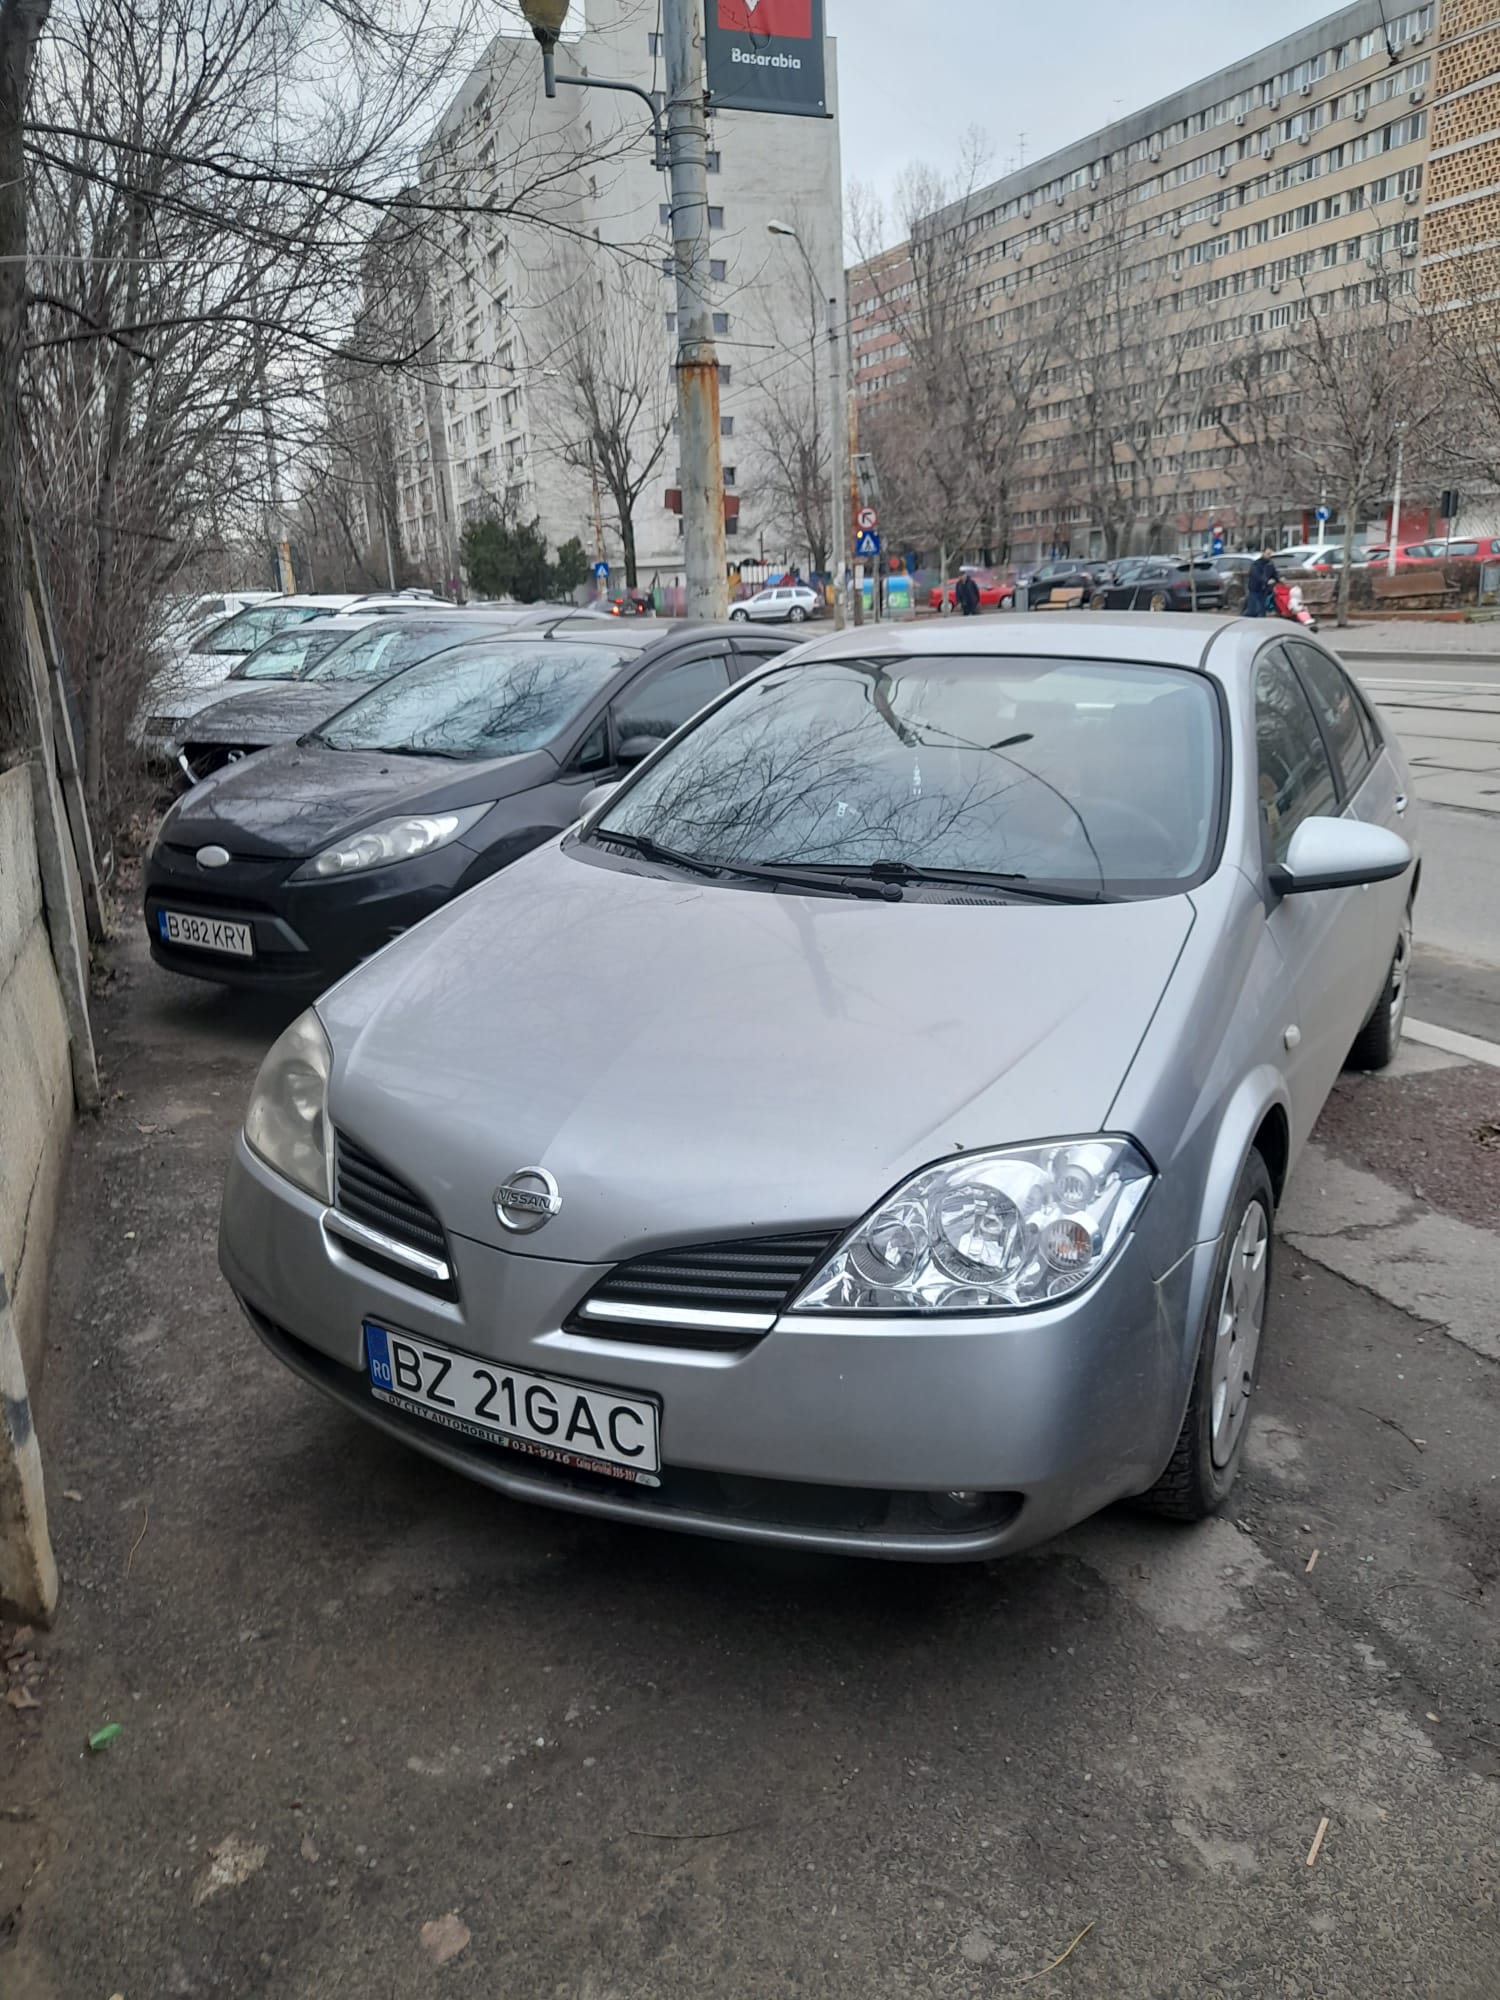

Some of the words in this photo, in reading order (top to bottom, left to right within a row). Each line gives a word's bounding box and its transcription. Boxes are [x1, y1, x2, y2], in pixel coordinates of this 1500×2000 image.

[731, 48, 801, 69] Basarabia
[497, 1189, 551, 1209] NISSAN
[372, 1359, 391, 1382] RO
[392, 1340, 457, 1408] BZ
[404, 1401, 429, 1417] CITY
[431, 1412, 508, 1446] AUTOMOBILE
